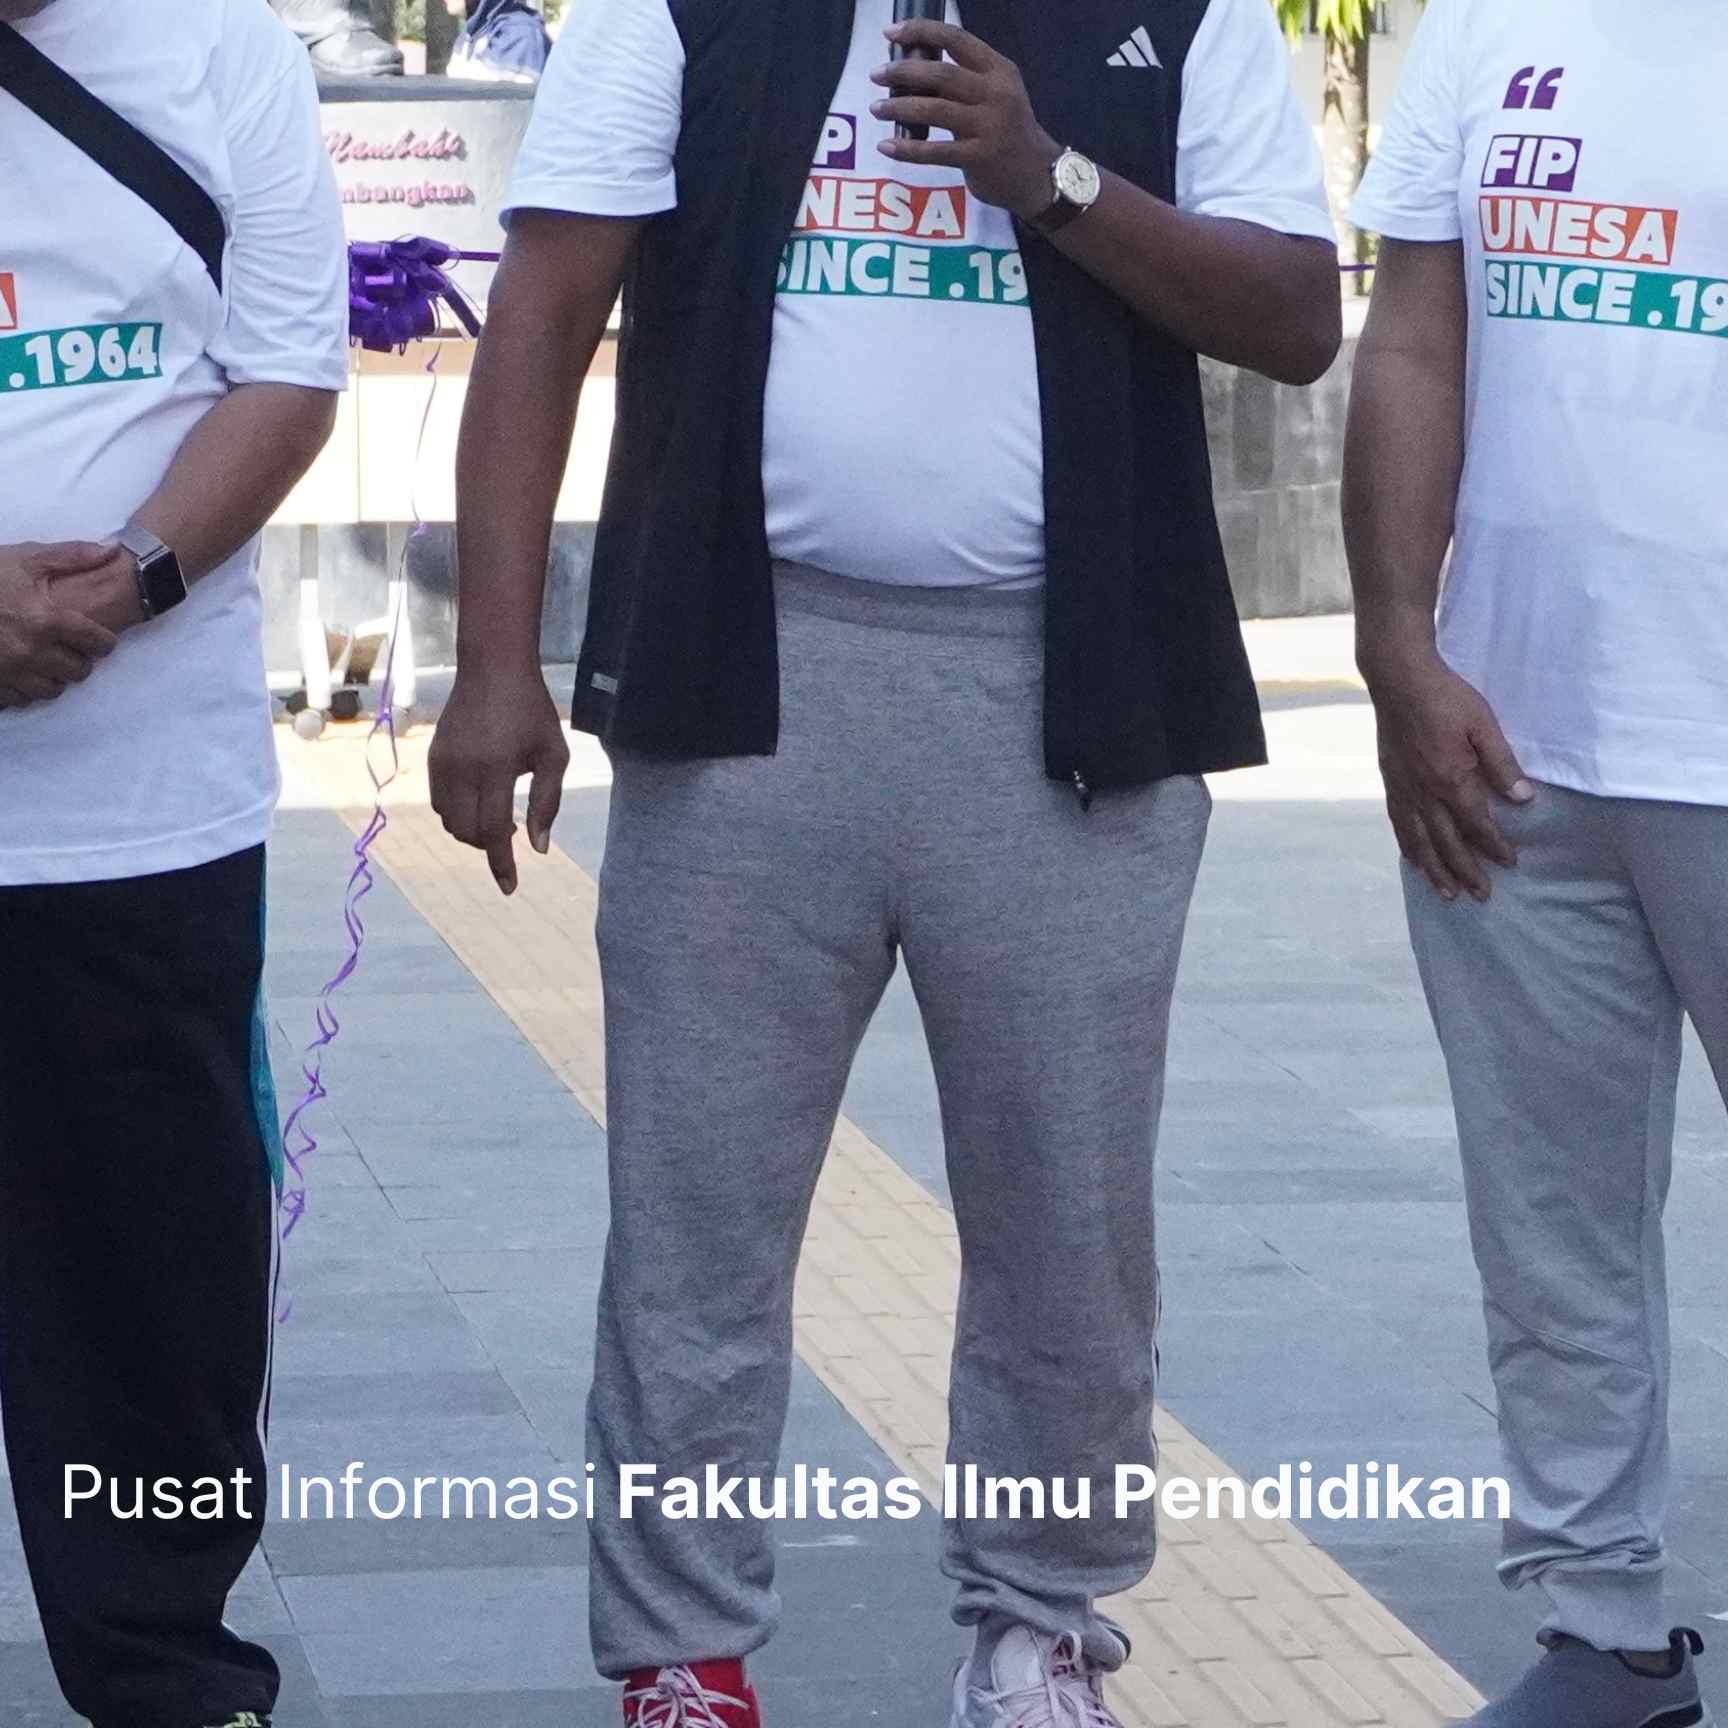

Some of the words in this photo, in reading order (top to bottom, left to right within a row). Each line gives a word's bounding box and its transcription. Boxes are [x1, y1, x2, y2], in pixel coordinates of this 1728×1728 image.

[1484, 136, 1579, 191] FIP
[793, 179, 961, 237] NESA
[1483, 199, 1671, 264] UNESA
[948, 251, 1028, 301] .19
[1487, 264, 1633, 320] SINCE
